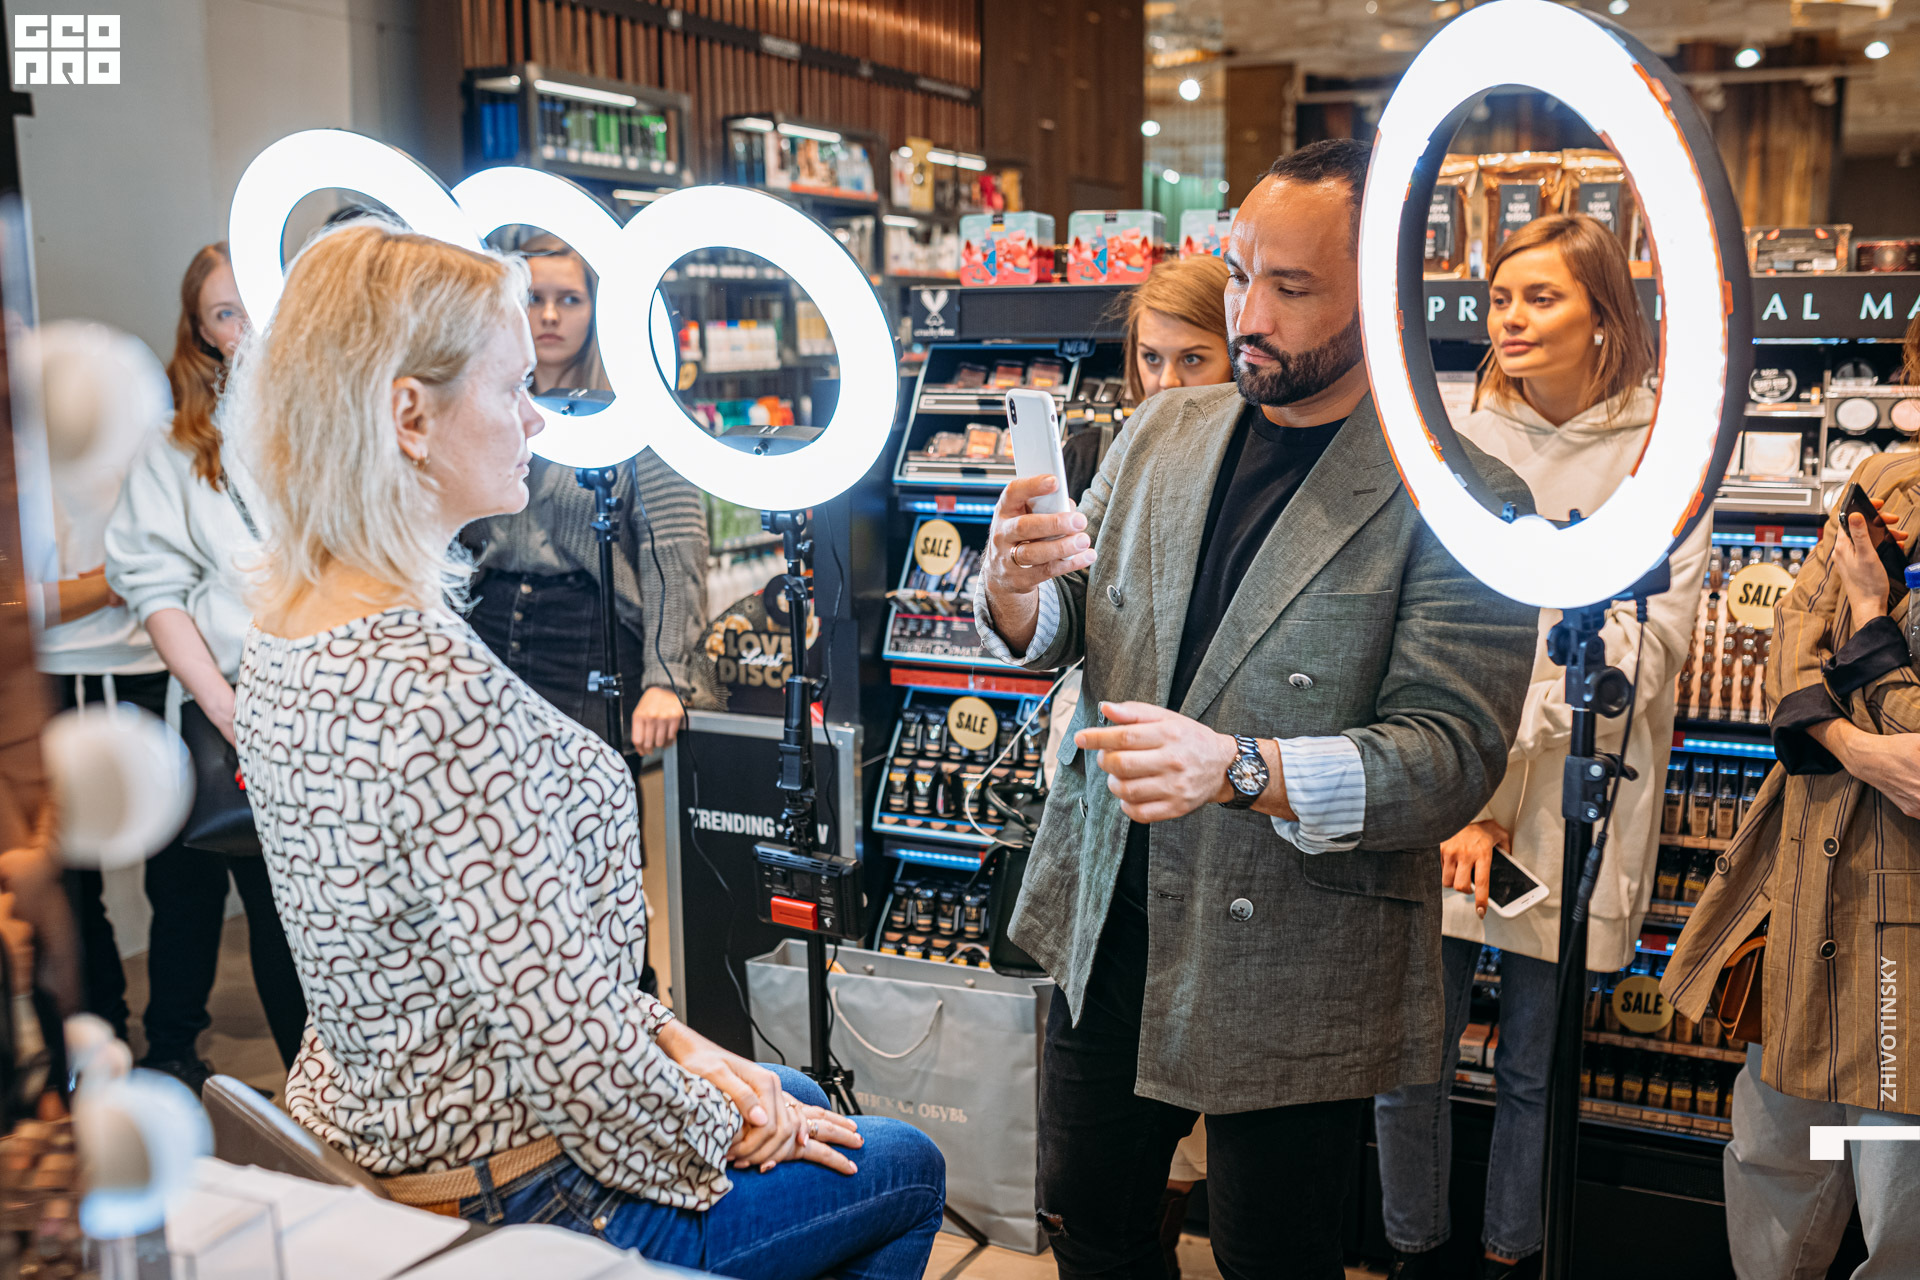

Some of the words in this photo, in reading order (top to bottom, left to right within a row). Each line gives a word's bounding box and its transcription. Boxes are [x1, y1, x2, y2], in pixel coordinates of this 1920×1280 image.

[1427, 296, 1478, 322] PR
[1761, 292, 1820, 320] AL
[921, 537, 953, 558] SALE
[1738, 583, 1787, 608] SALE
[956, 711, 989, 735] SALE
[1621, 991, 1664, 1016] SALE
[918, 1103, 968, 1123] ОБУВЬ
